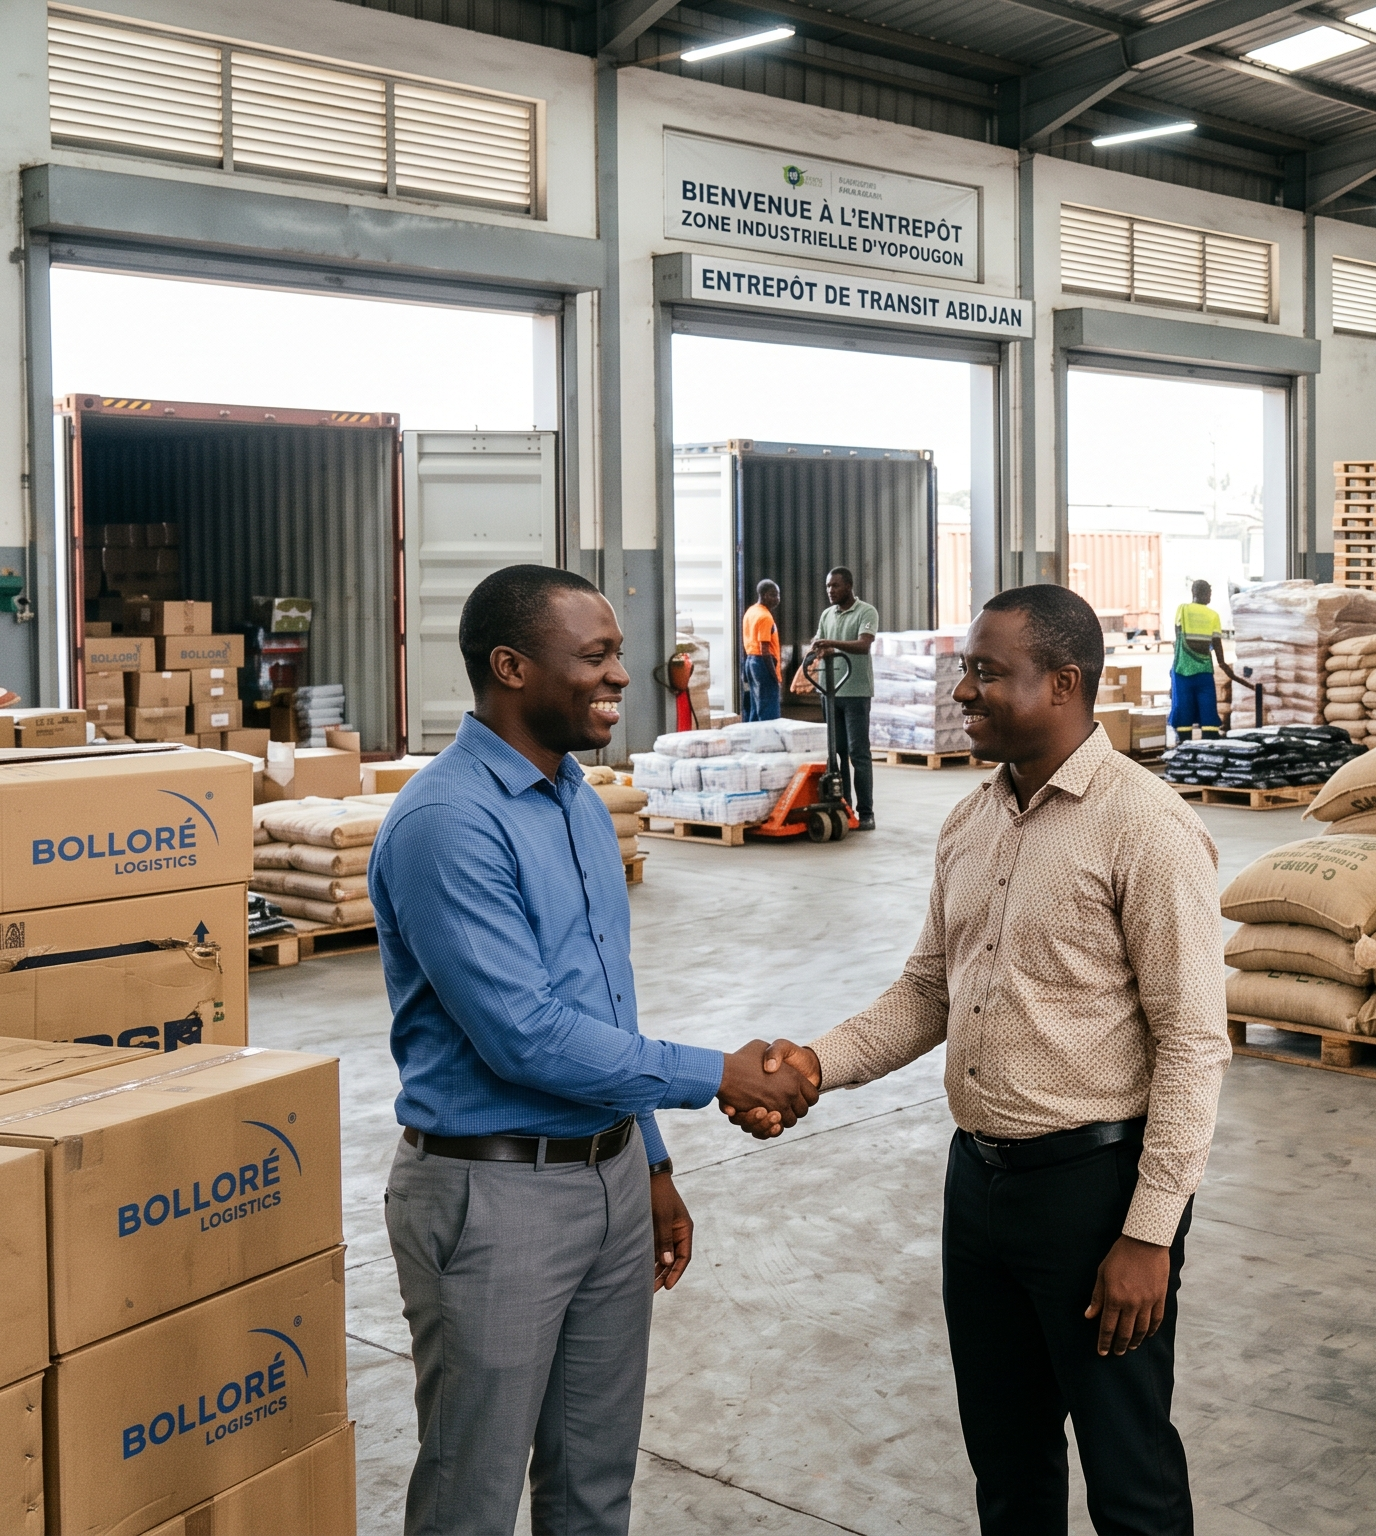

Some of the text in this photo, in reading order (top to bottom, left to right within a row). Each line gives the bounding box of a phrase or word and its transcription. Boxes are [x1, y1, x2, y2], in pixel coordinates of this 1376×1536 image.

[681, 180, 812, 220] BIENVENUE
[819, 199, 834, 224] À
[681, 210, 964, 267] ZONE INDUSTRIELLE D'YOPOUGON
[701, 268, 1022, 327] ENTREPÔT DE TRANSIT ABIDJAN
[32, 817, 197, 865] BOLLORÉ
[115, 854, 197, 875] LOGISTICS
[118, 1147, 281, 1238] BOLLORÉ
[200, 1190, 282, 1233] LOGISTICS
[122, 1351, 286, 1461] BOLLORÉ
[205, 1395, 287, 1446] LOGISTICS
